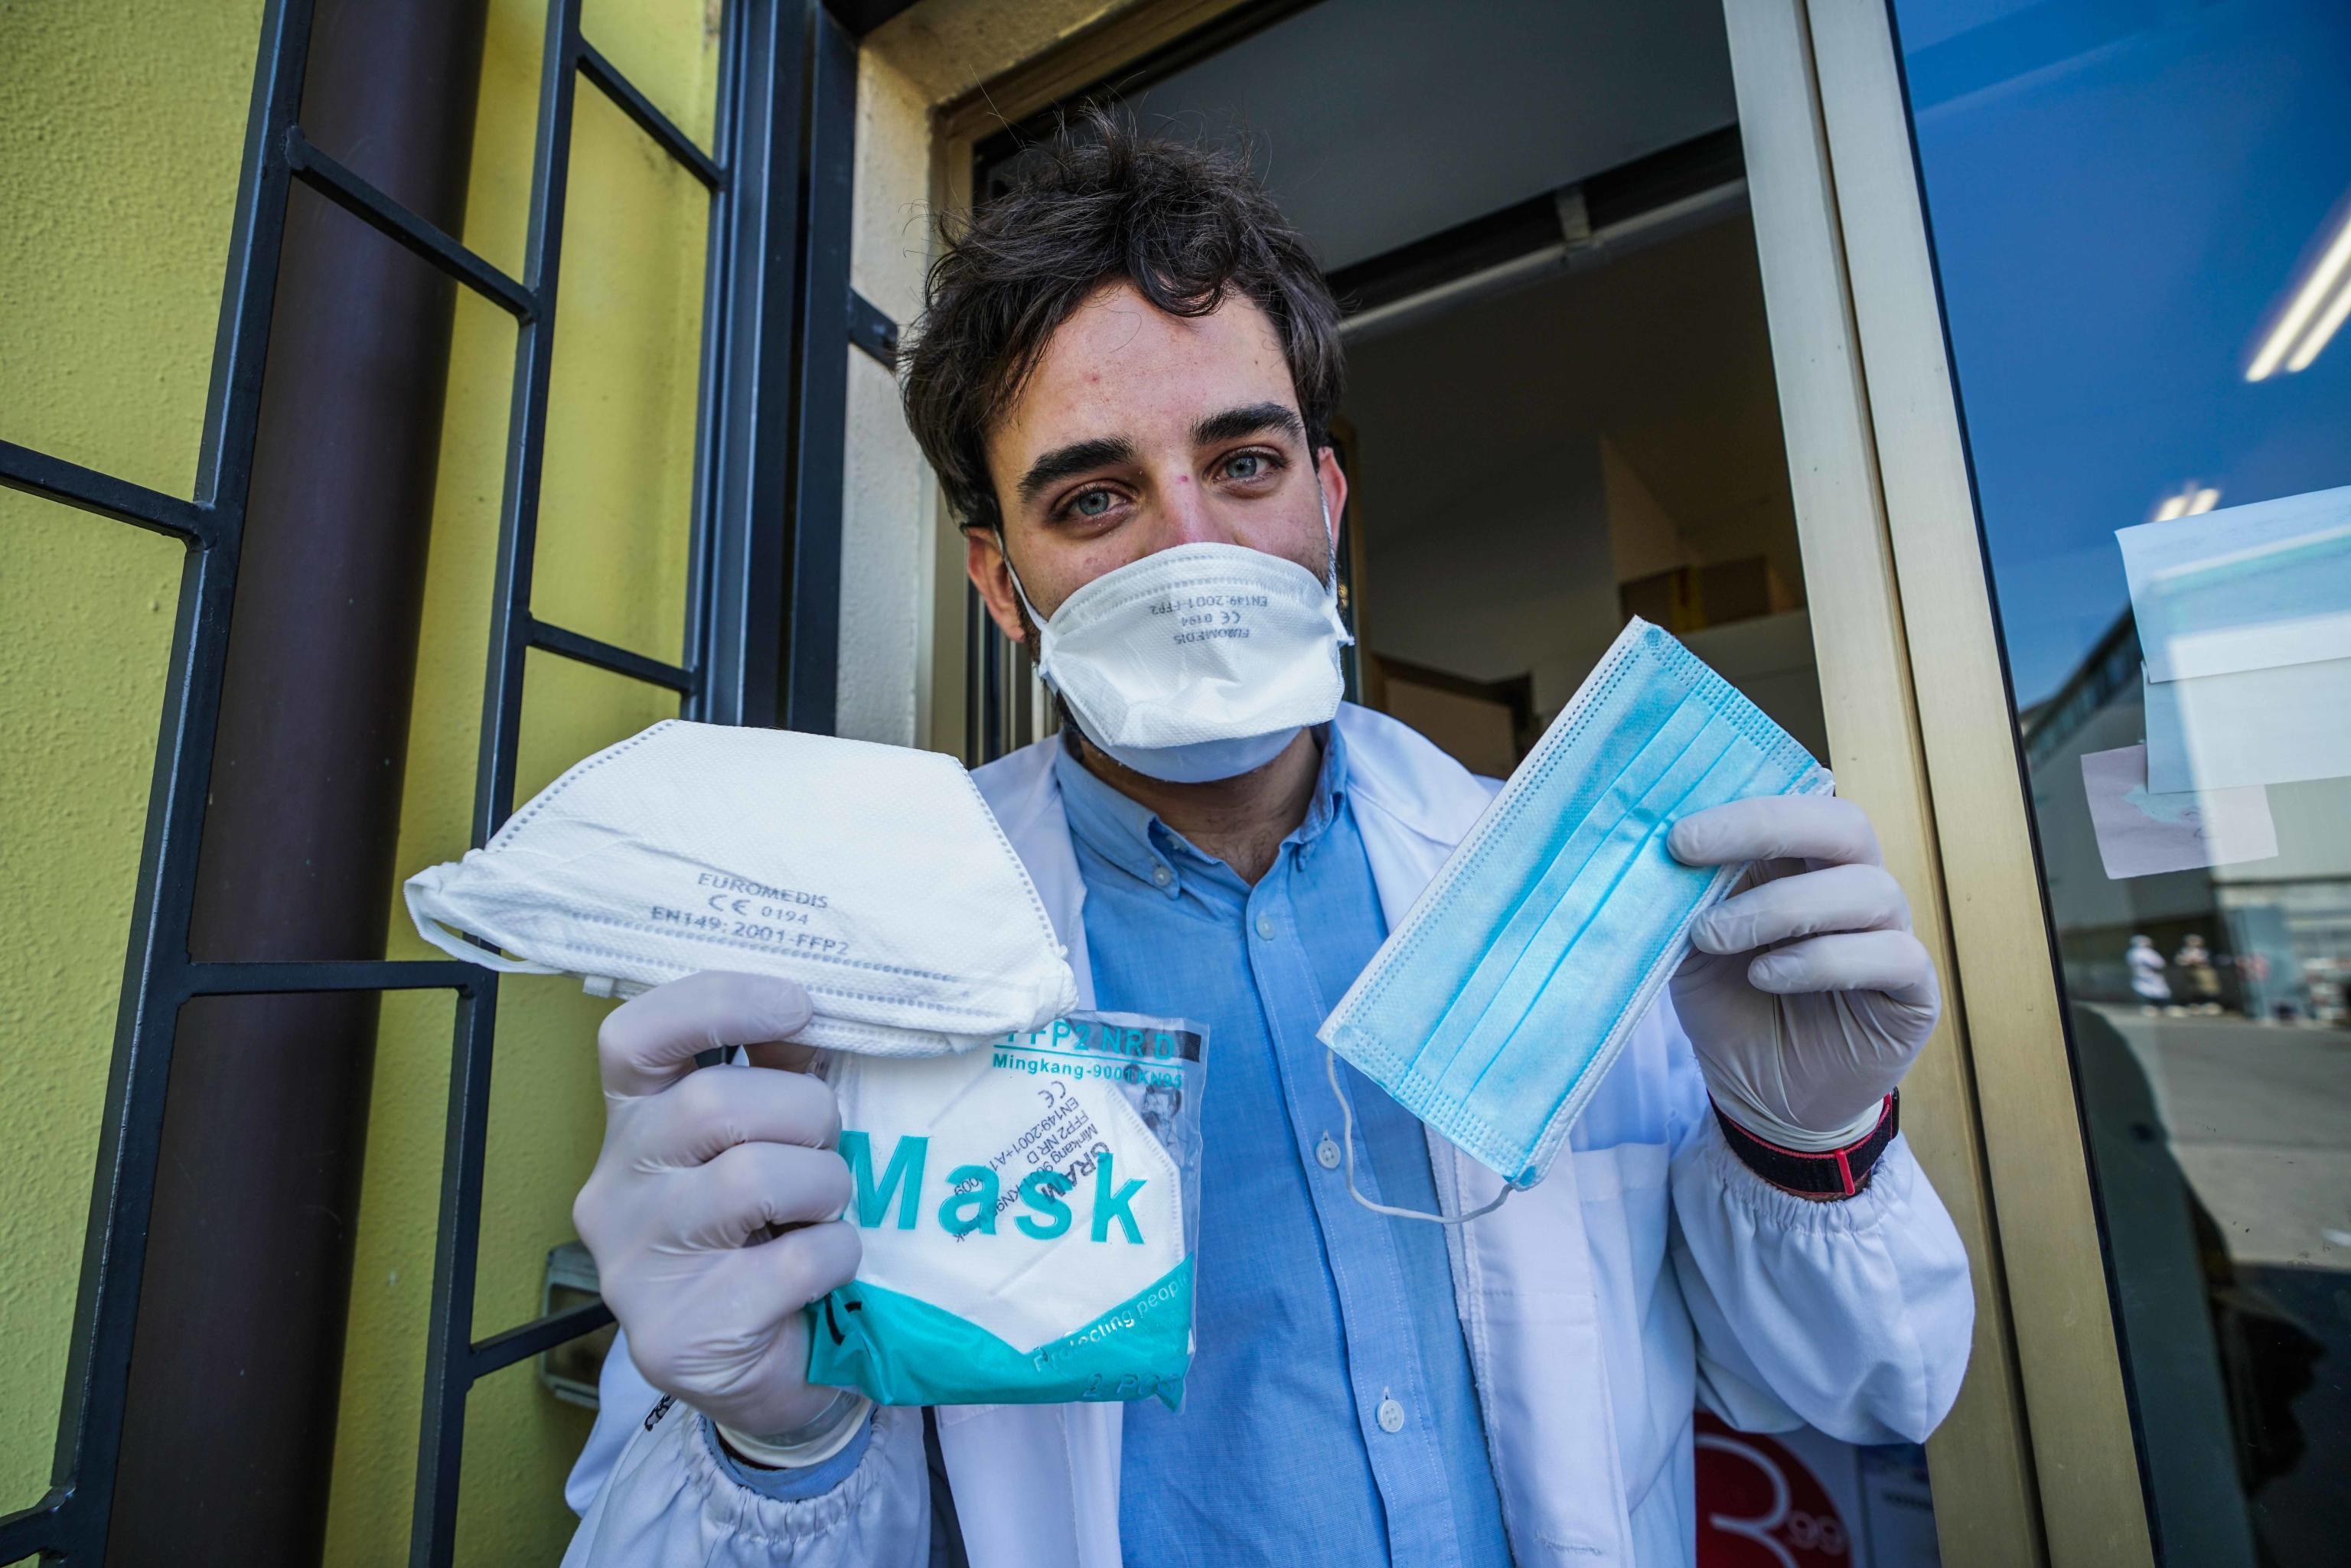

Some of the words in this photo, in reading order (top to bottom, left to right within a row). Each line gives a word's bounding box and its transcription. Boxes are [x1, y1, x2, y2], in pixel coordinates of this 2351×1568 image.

[1181, 613, 1213, 628] 0194
[697, 872, 828, 909] EUROMEDIS
[761, 905, 809, 925] 0194
[1102, 1026, 1146, 1058] NR
[1154, 1033, 1175, 1061] D
[1137, 1070, 1182, 1088] KN95
[1057, 1110, 1090, 1140] FFP2
[1037, 1134, 1060, 1156] NR
[1026, 1150, 1040, 1165] D
[840, 1130, 1148, 1245] Mask
